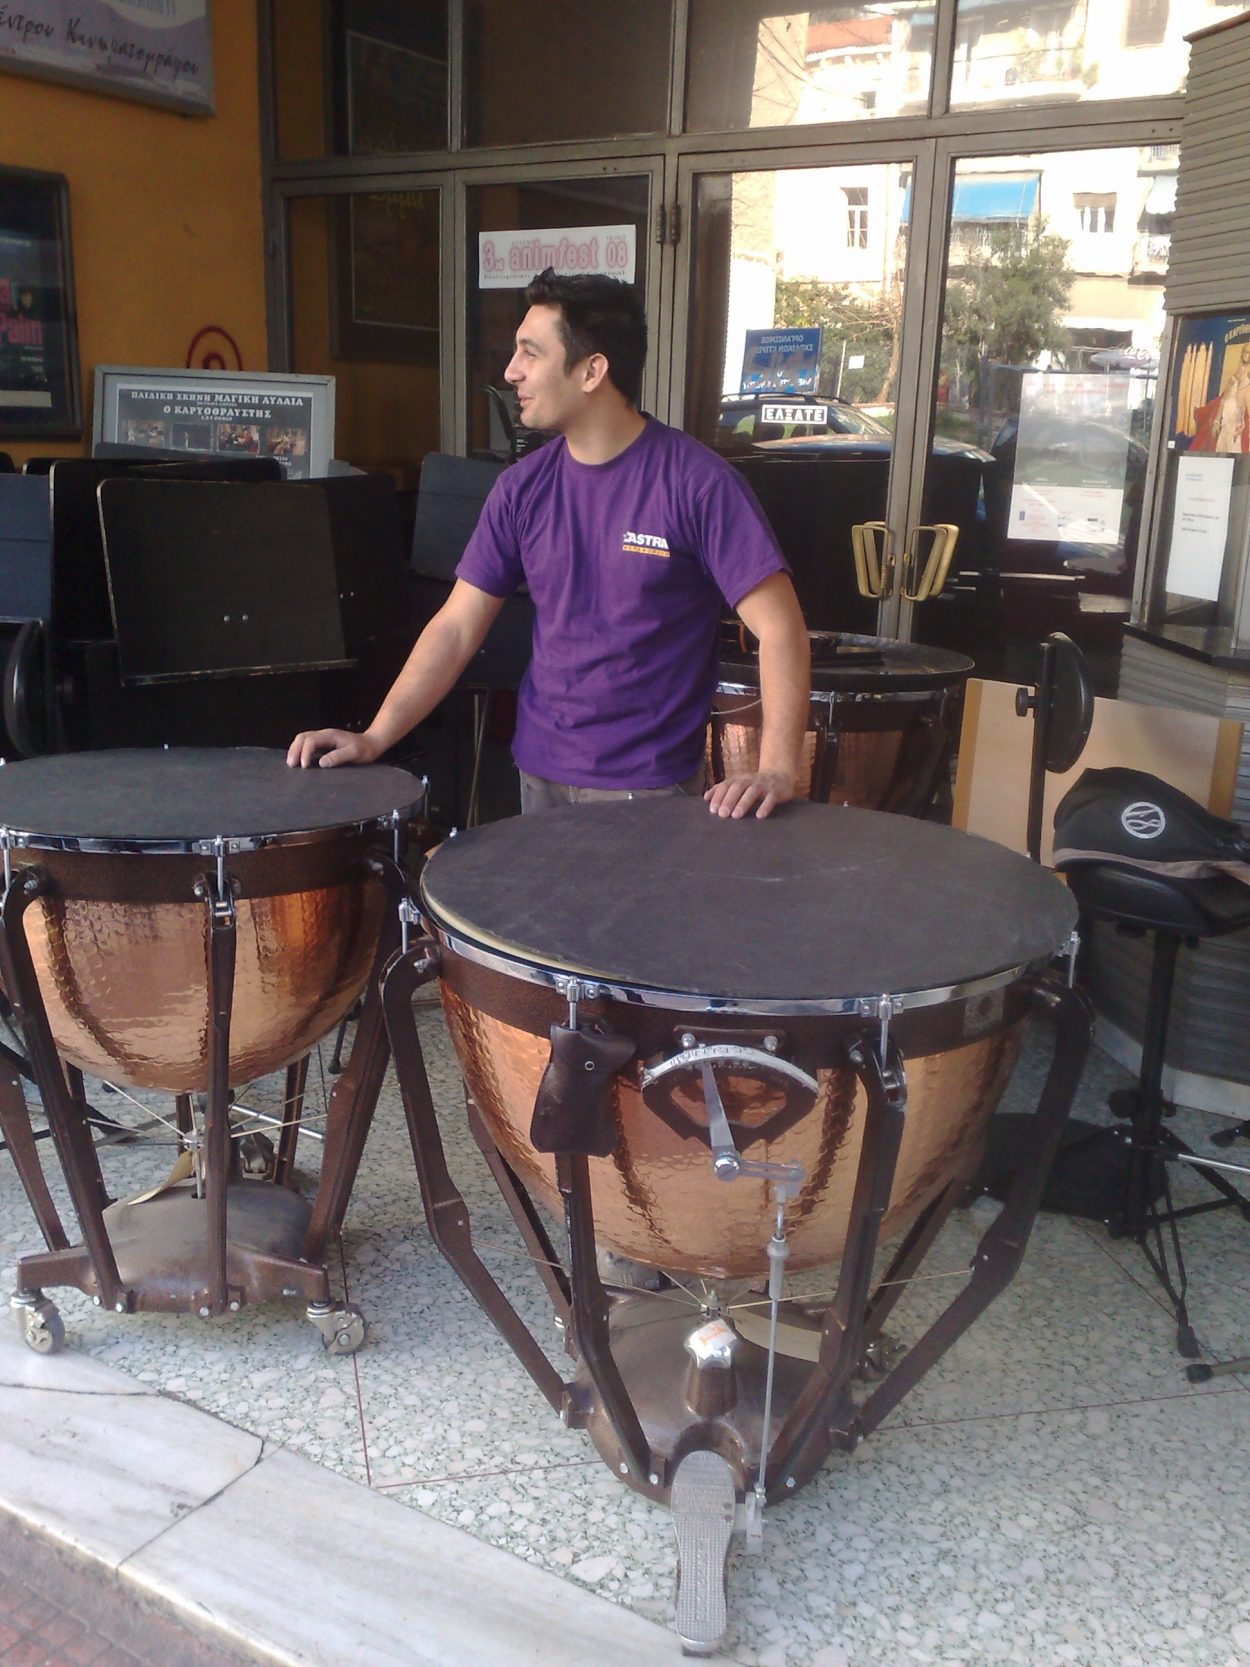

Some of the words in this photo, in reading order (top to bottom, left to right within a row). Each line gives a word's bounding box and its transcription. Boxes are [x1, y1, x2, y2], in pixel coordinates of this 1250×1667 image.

[509, 236, 599, 272] animfest
[606, 240, 628, 268] 08
[131, 391, 174, 400] ΠΑΙΔΙΚΗ
[176, 392, 211, 402] ΣΚΗΝΗ
[214, 393, 259, 404] ΜΑΓΙΚΗ
[262, 396, 304, 406] ΑΥΛΑΙΑ
[174, 405, 272, 419] ΚΑΡΥΟΘΡΑΥΣΤΗΣ
[765, 408, 824, 422] ΕΛΞΑΤΕ
[624, 531, 669, 550] ASTRA
